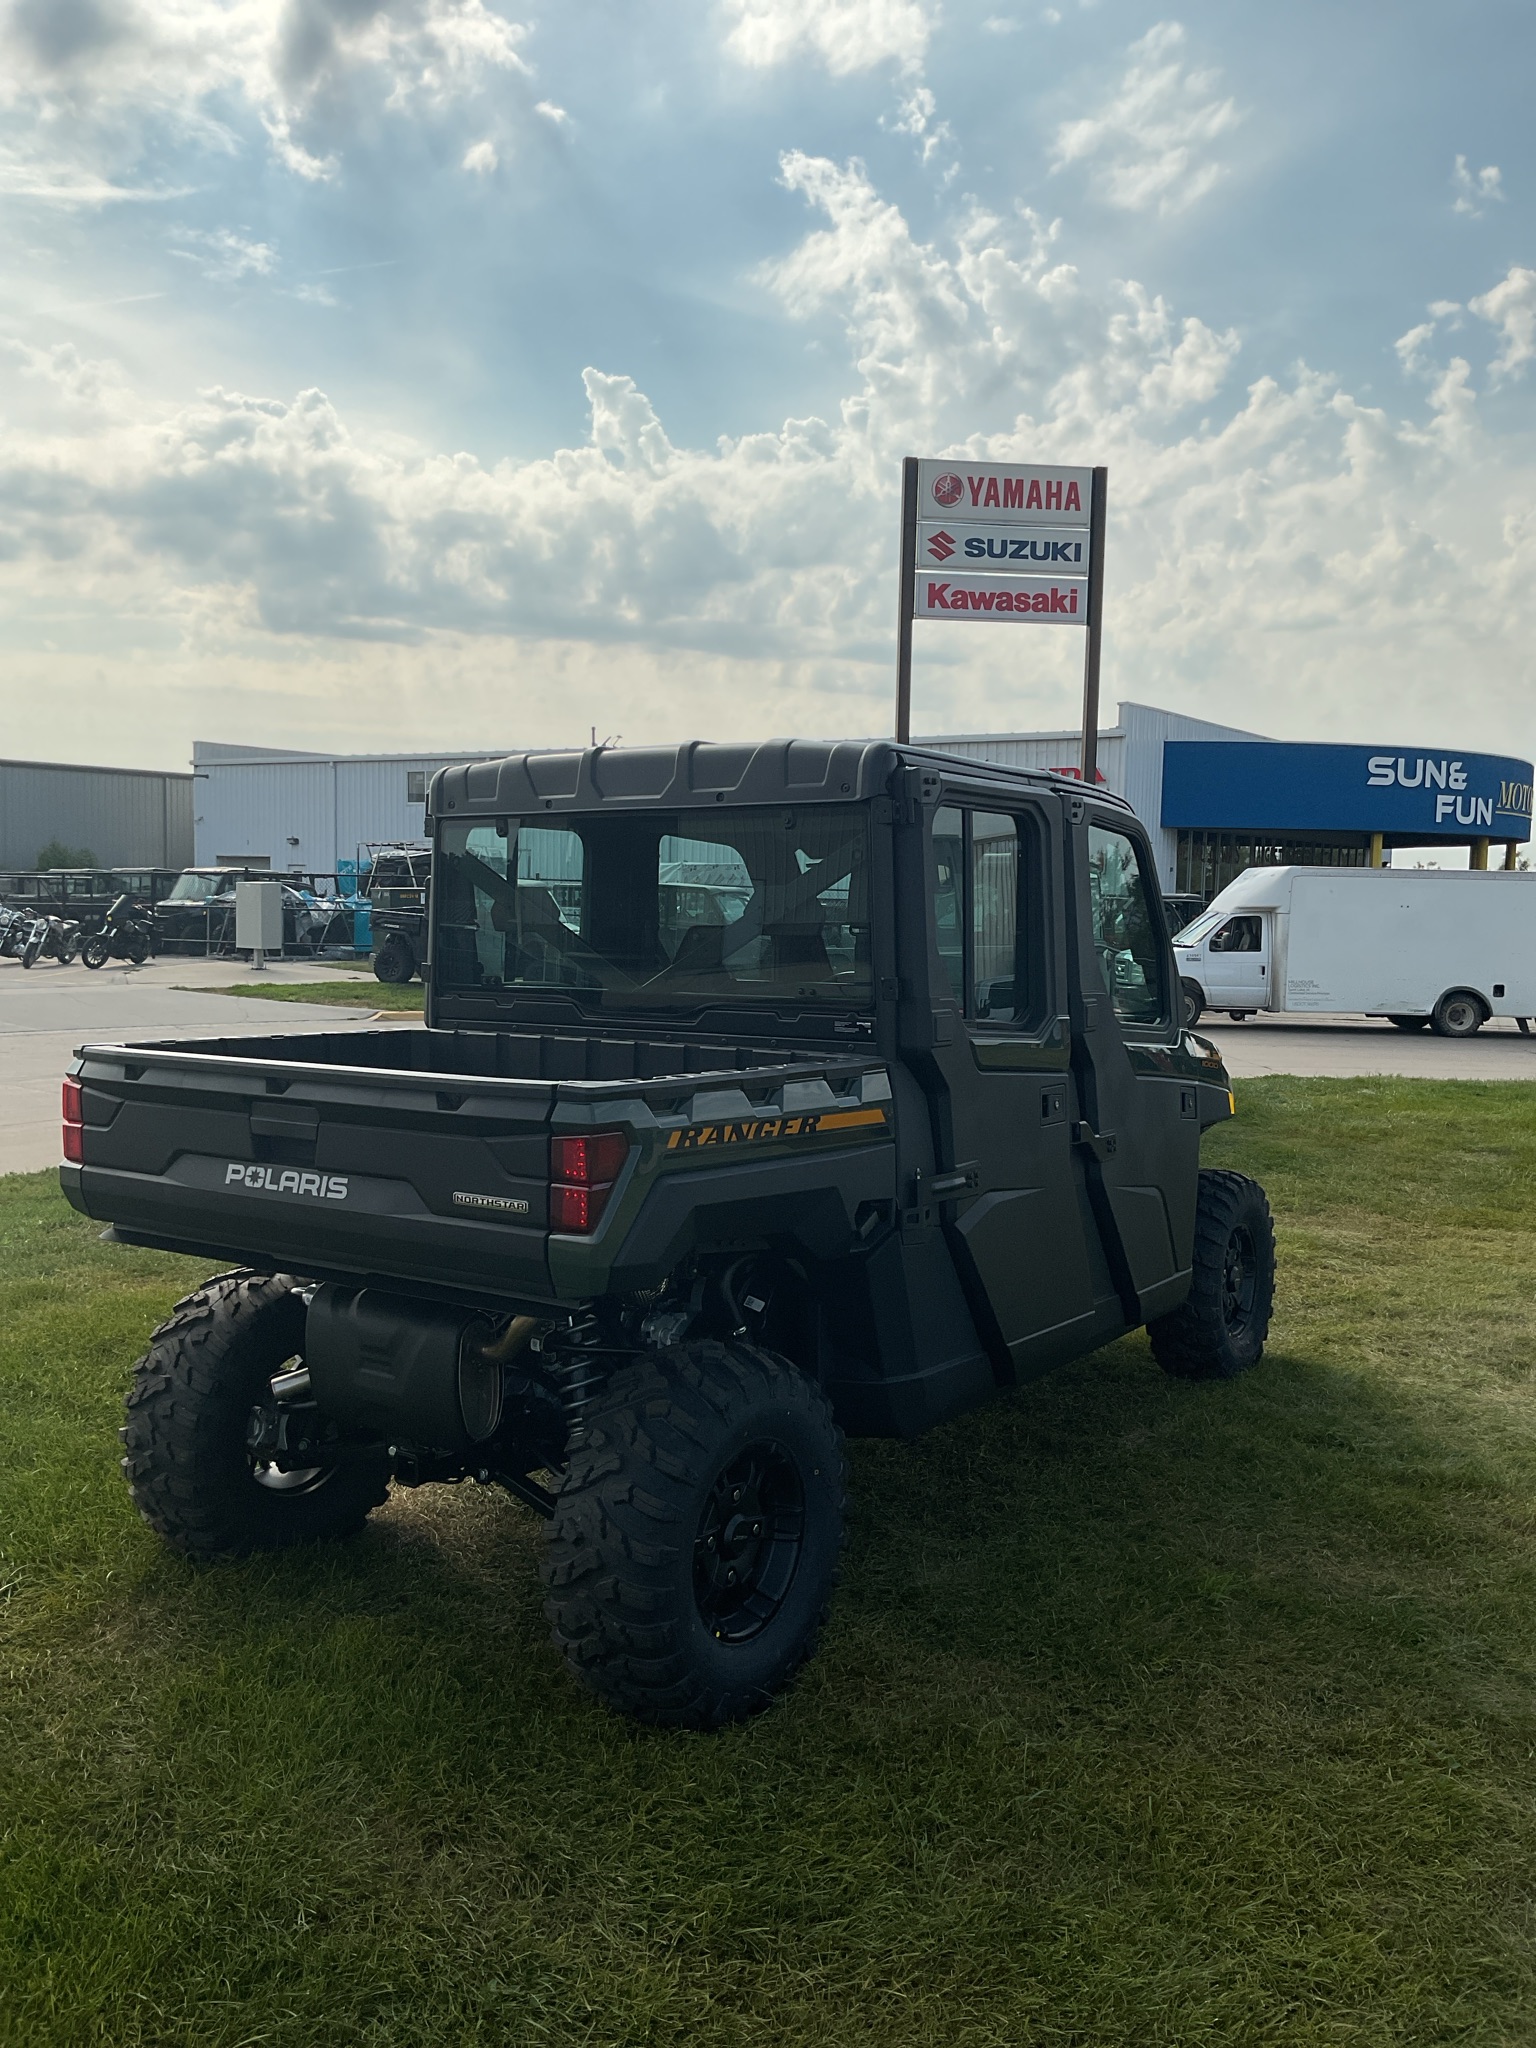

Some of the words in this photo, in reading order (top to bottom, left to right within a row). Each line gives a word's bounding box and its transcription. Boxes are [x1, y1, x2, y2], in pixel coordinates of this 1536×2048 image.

[967, 476, 1081, 511] YAMAHA
[964, 537, 1082, 562] SUZUKI
[927, 582, 1078, 613] Kawasaki
[1435, 794, 1493, 826] FUN
[675, 1114, 822, 1150] RANGER
[225, 1163, 349, 1200] POLARIS
[456, 1194, 525, 1211] NORTHSTAR
